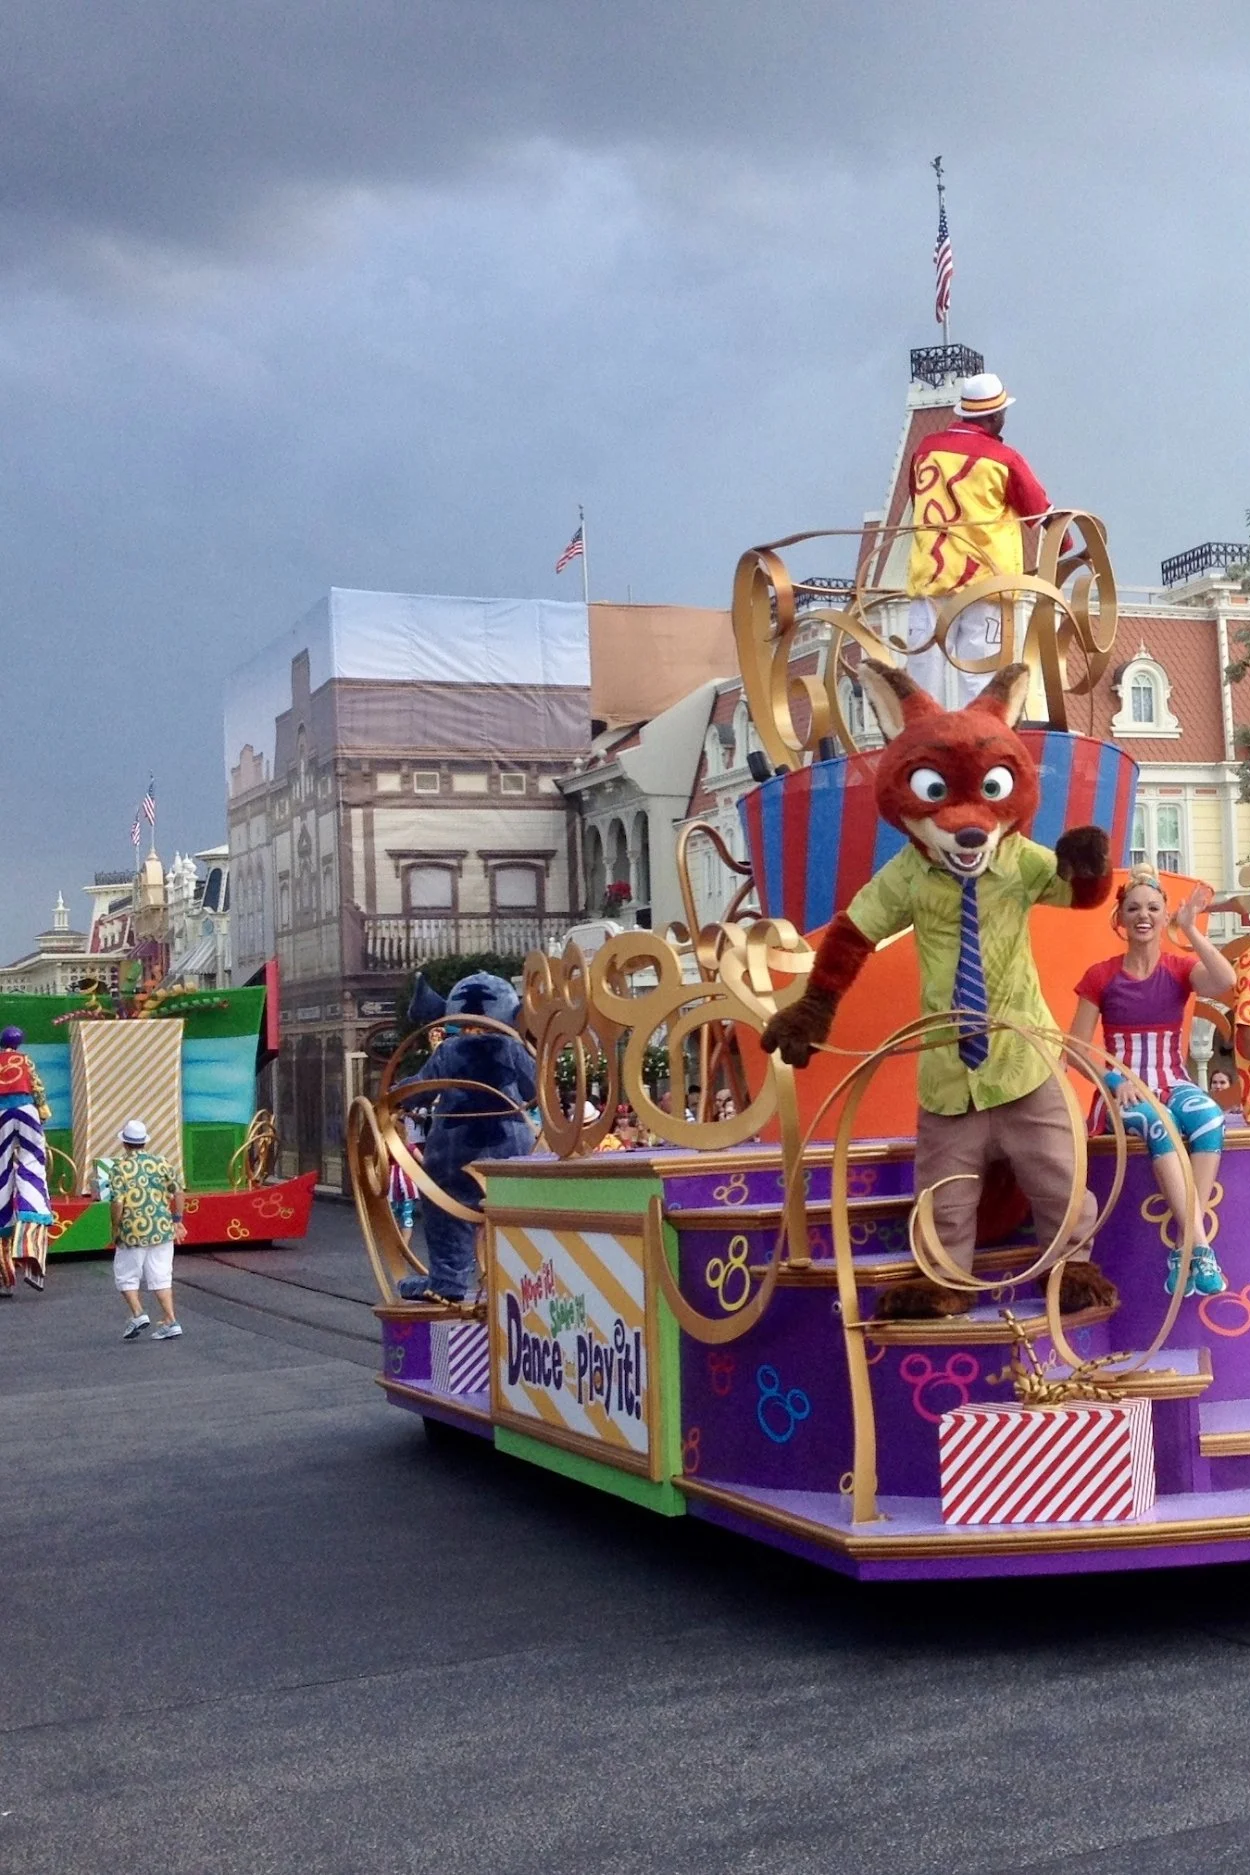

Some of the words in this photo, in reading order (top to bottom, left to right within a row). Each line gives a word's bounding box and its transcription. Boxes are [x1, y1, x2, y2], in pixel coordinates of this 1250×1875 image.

[507, 1293, 563, 1391] Dance
[576, 1332, 614, 1416] Play
[613, 1319, 642, 1421] it!
